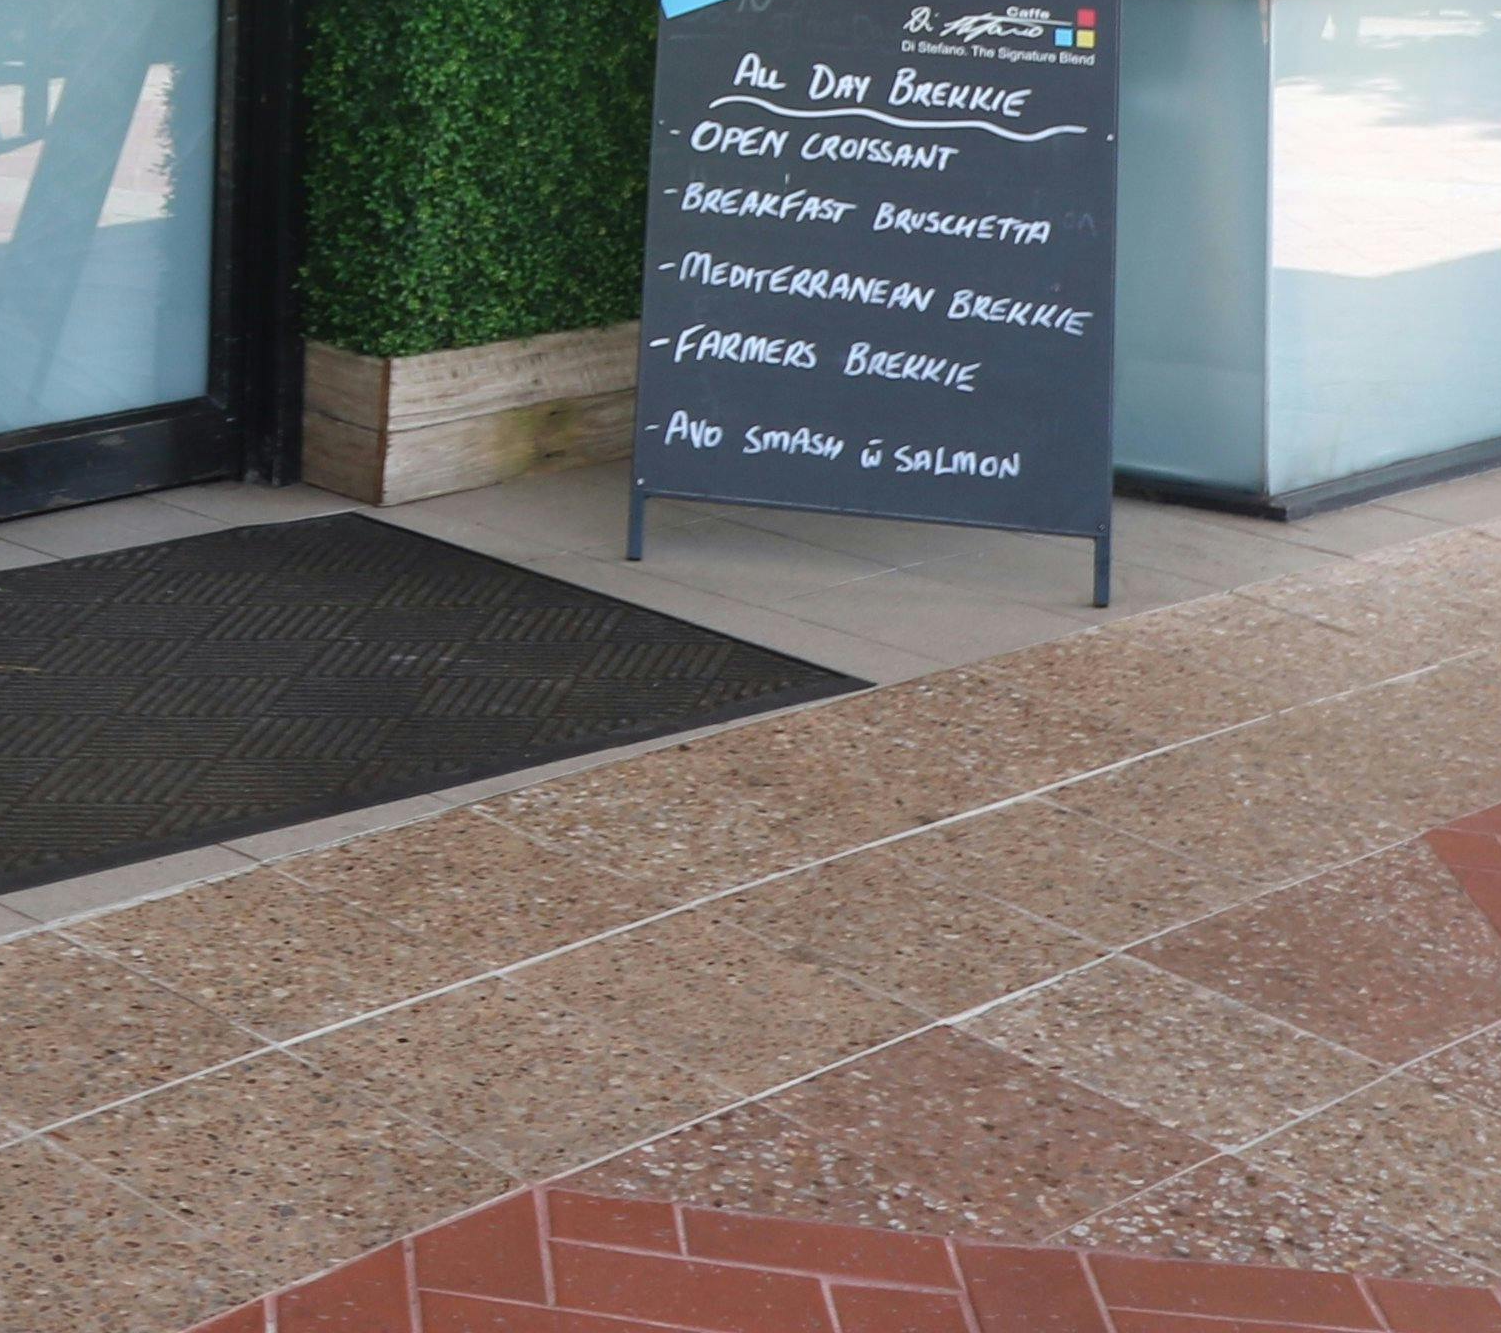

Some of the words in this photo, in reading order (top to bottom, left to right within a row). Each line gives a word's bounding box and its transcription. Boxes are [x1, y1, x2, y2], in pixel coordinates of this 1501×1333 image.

[901, 40, 915, 53] Di
[917, 42, 967, 57] Stefano.
[971, 45, 995, 59] The
[997, 47, 1057, 64] Signature
[1059, 51, 1096, 66] Blend
[808, 64, 871, 103] DAY
[887, 67, 1032, 118] BREKKIE
[690, 121, 789, 160] OPEN
[800, 132, 958, 173] CROISSANT
[681, 182, 856, 224] BREAKFAST
[872, 199, 1052, 245] BRUSCHETTA
[947, 289, 1093, 337] BREKKIE
[674, 324, 818, 371] FARMERS
[845, 343, 982, 393] BREKKIE
[742, 425, 844, 461] SMASH
[894, 445, 1022, 480] SALMON
